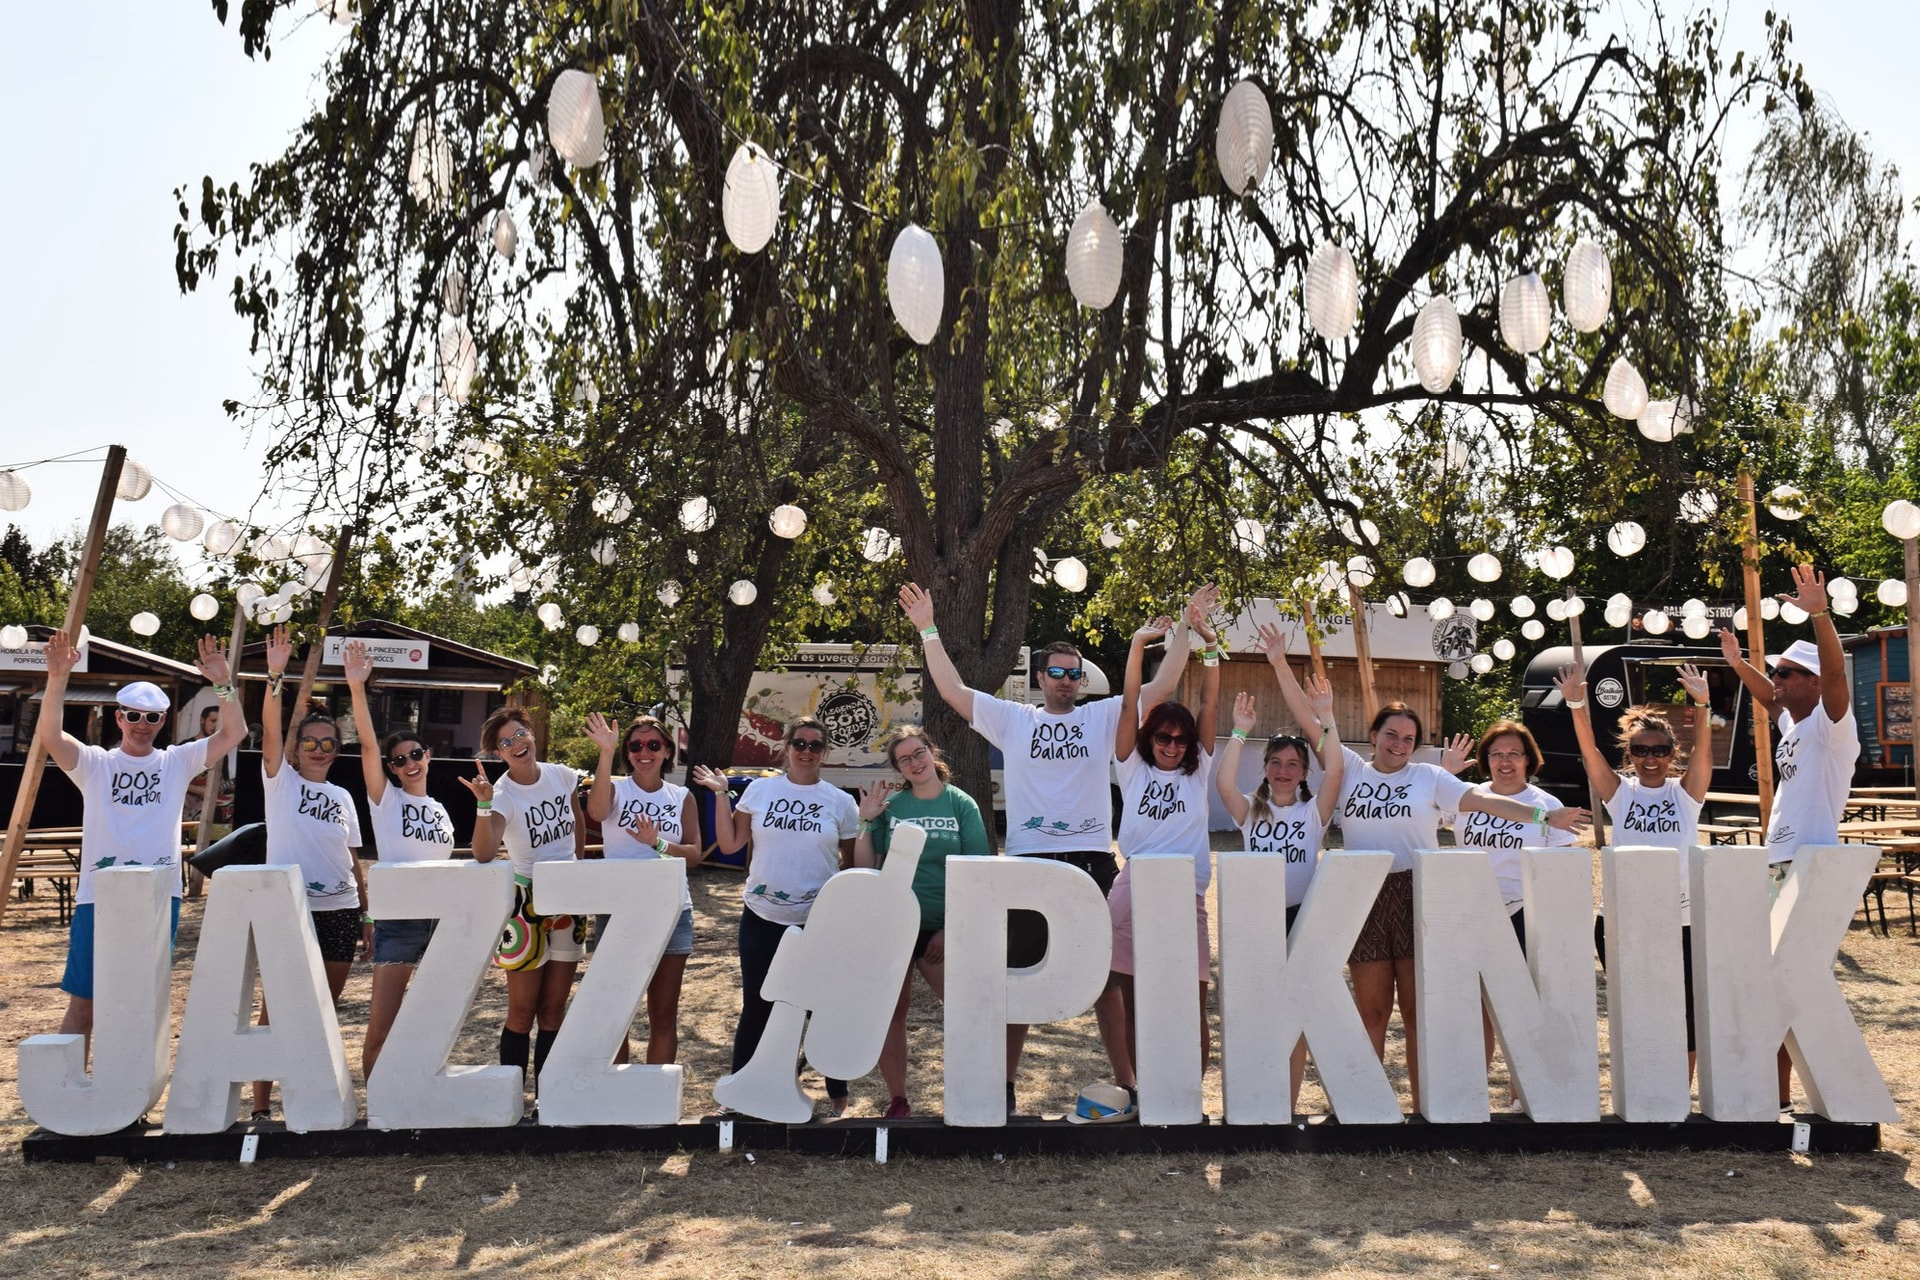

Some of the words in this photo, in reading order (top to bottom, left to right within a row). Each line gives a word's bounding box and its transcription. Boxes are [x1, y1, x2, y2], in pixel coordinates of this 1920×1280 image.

[1705, 606, 1733, 618] ISTRO
[1032, 722, 1085, 741] 100%
[1030, 739, 1090, 760] Balaton
[1144, 780, 1180, 802] 100
[1351, 782, 1412, 801] 100%
[525, 794, 570, 828] 100%
[623, 799, 677, 817] 100%
[768, 798, 824, 819] 100%
[1344, 797, 1412, 819] Balaton
[1629, 800, 1675, 818] 100%
[402, 818, 453, 844] Balato
[618, 810, 680, 836] Baton
[762, 811, 822, 834] Balaton
[894, 818, 956, 829] NTOR
[1250, 820, 1306, 840] 100%
[1467, 811, 1524, 830] 100%
[1624, 811, 1681, 833] Balaton
[1464, 825, 1523, 849] Balaton
[18, 858, 687, 1135] JAZZ
[944, 844, 1900, 1126] PIKNIK
